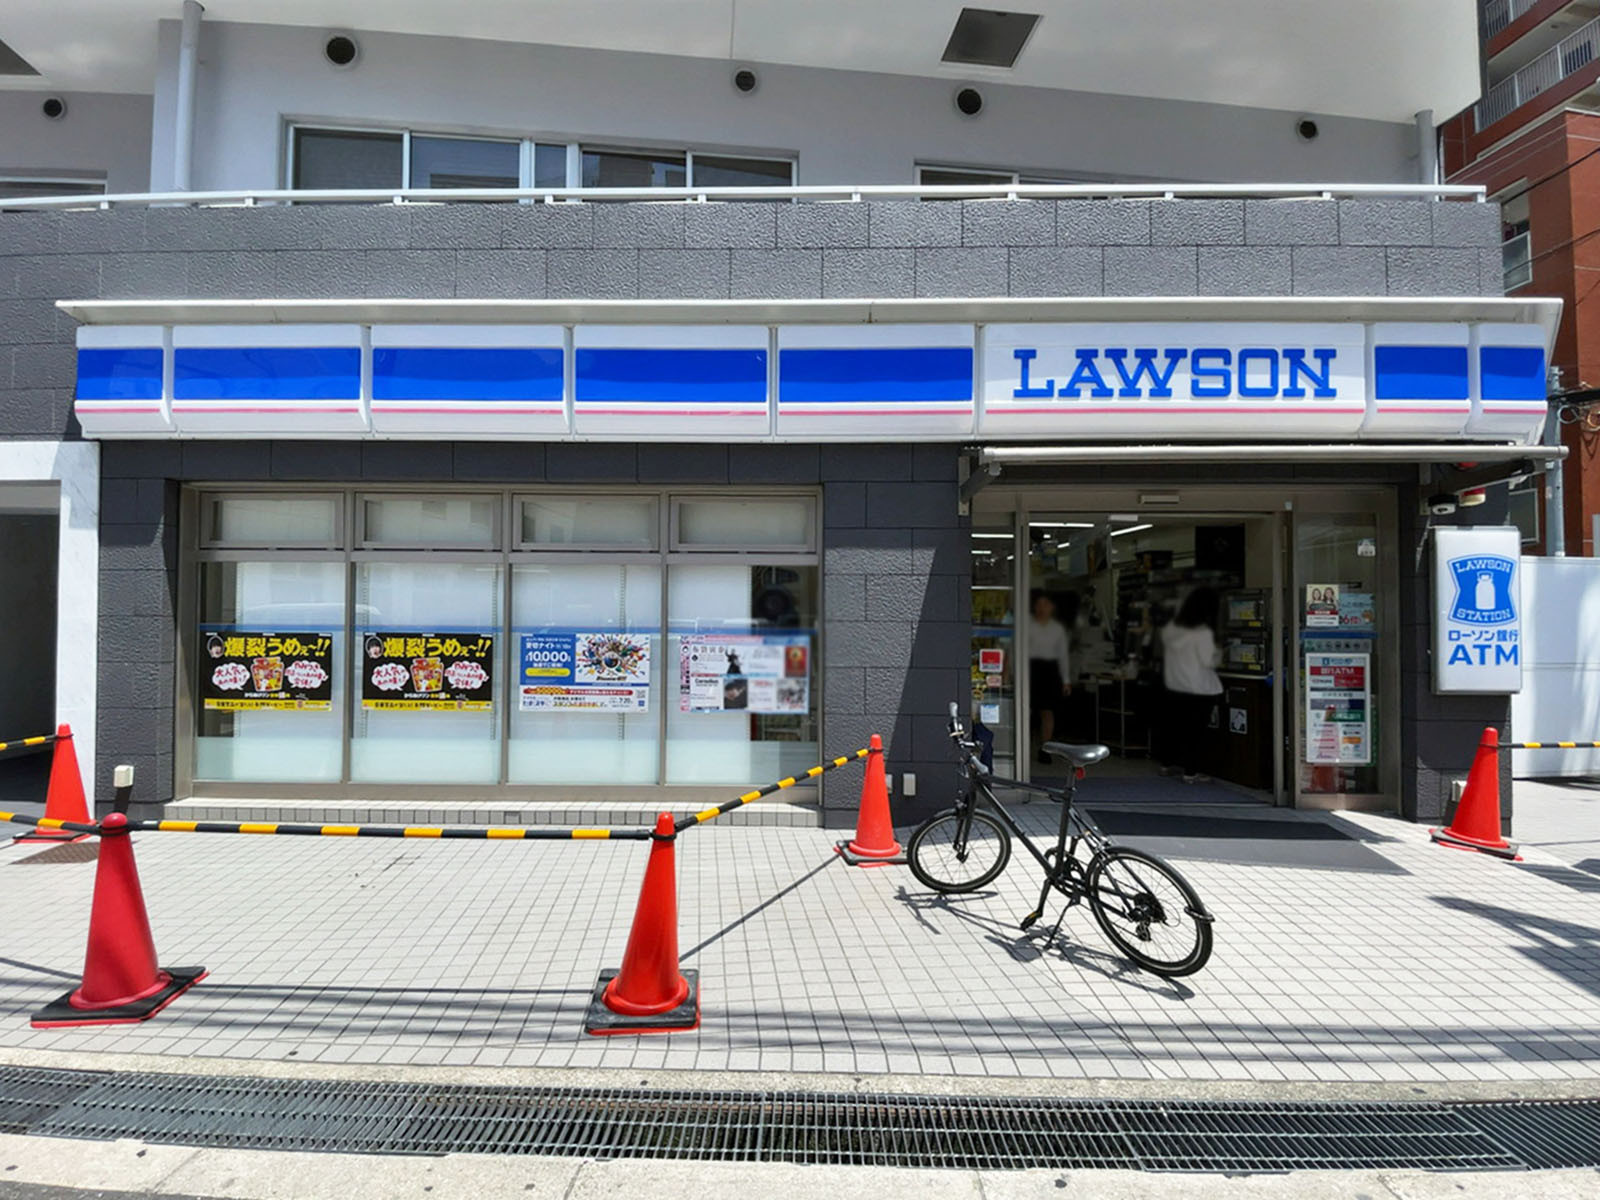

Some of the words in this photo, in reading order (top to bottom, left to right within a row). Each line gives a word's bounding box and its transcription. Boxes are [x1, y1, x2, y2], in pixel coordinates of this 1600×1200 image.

[1012, 348, 1338, 398] LAWSON
[1455, 559, 1512, 573] LAWSON
[1456, 608, 1512, 622] STATION
[1448, 629, 1519, 642] ローソン銀行
[1448, 643, 1519, 666] ATM
